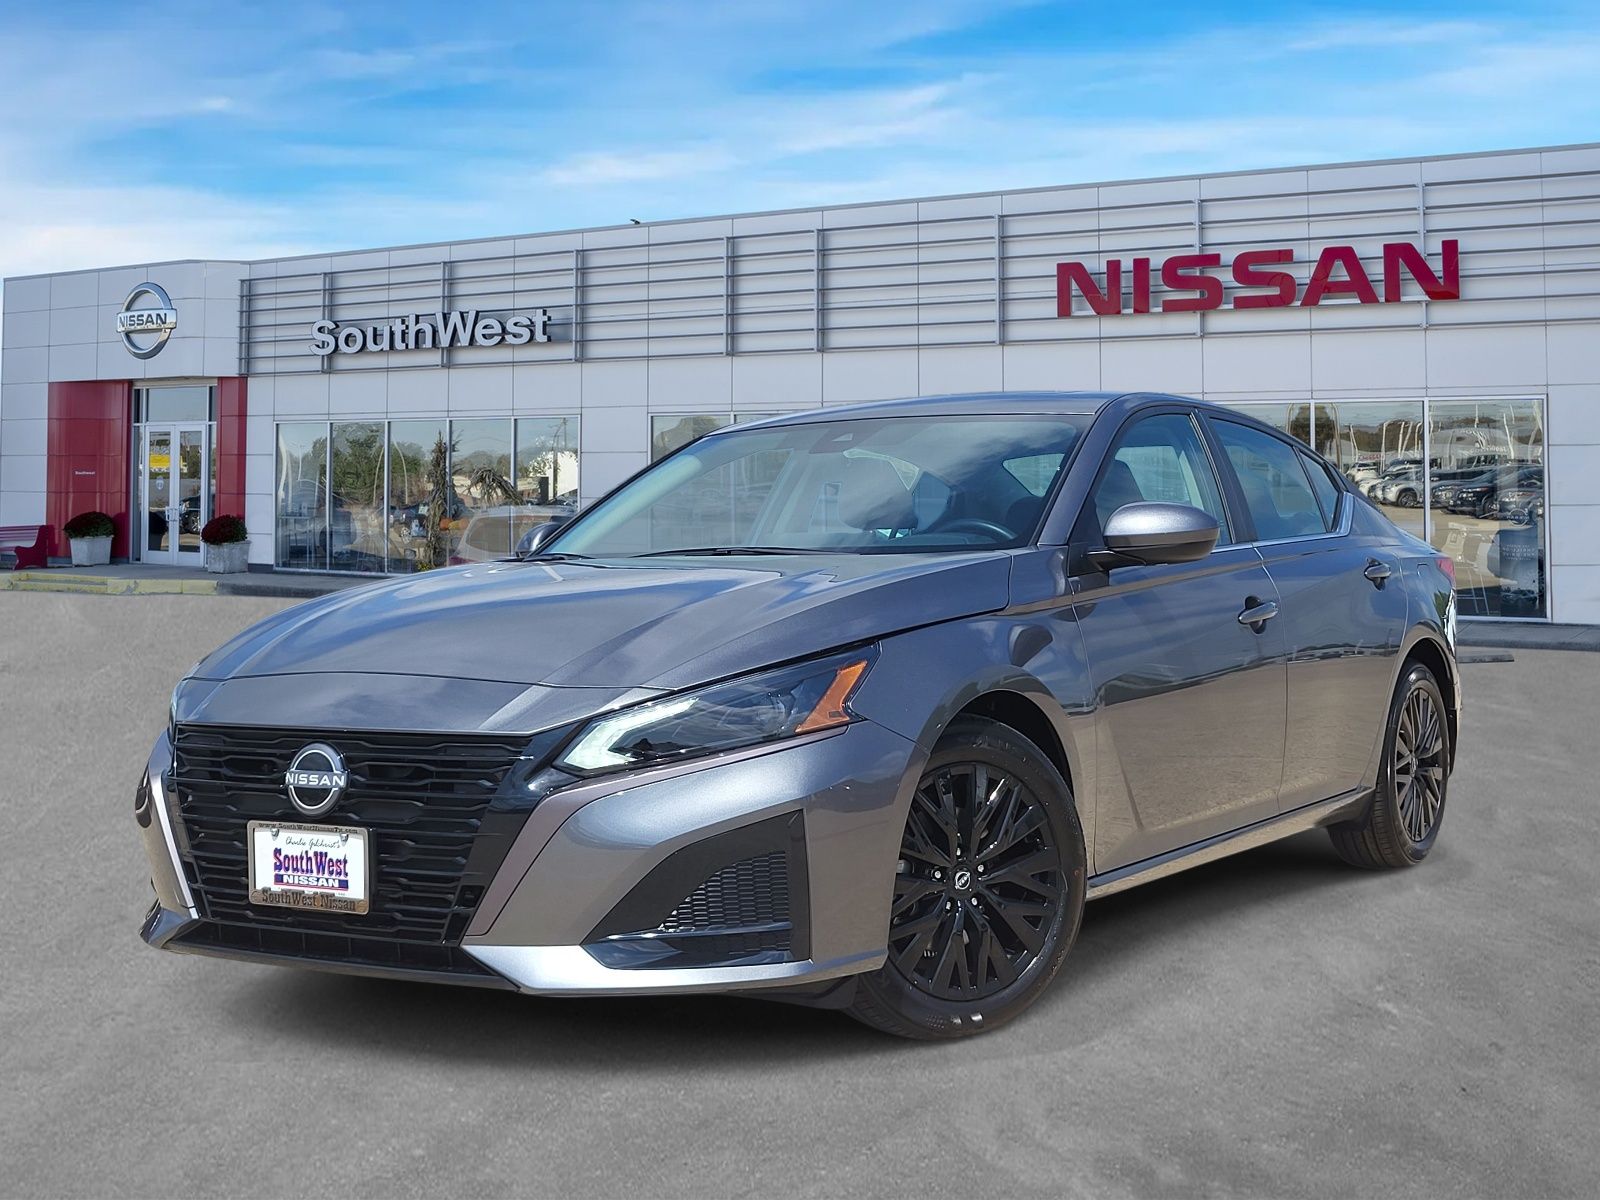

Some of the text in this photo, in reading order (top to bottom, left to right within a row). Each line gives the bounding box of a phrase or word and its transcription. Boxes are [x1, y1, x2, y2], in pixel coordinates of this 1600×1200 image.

[1056, 239, 1461, 317] NISSAN
[117, 311, 168, 328] NISSAN
[310, 308, 552, 356] SouthWest
[285, 772, 345, 787] NISSAN
[273, 847, 349, 878] SouthWest
[282, 874, 339, 888] NISSAN
[262, 889, 356, 911] SouthWest Nissan
